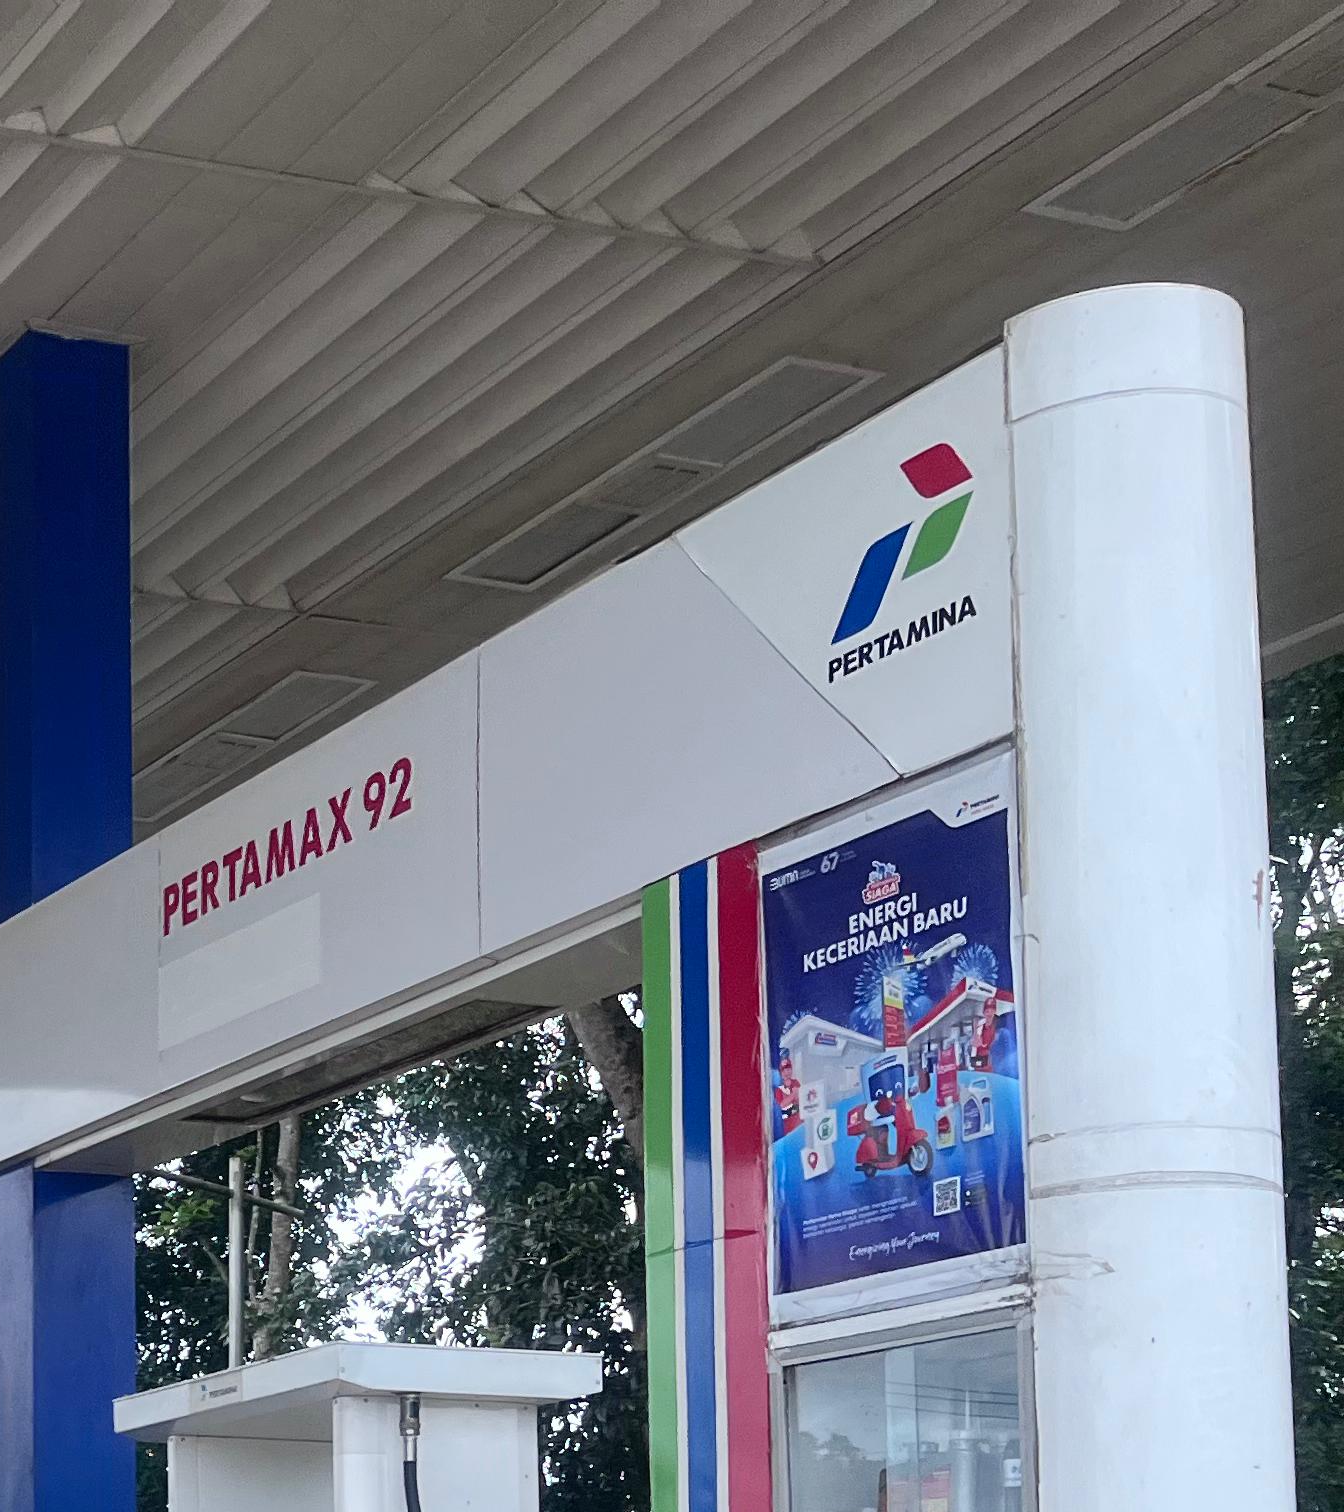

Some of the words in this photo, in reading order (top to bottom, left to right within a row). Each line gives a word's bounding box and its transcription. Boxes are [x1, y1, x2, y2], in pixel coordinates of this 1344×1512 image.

[828, 594, 977, 684] PERTAMINA
[162, 786, 353, 937] PERTAMAX
[362, 756, 413, 831] 92
[820, 852, 840, 874] 67
[848, 892, 917, 935] ENERGI
[866, 882, 897, 900] SIAGA
[803, 920, 909, 973] KECERIAAN
[913, 896, 968, 934] BARU
